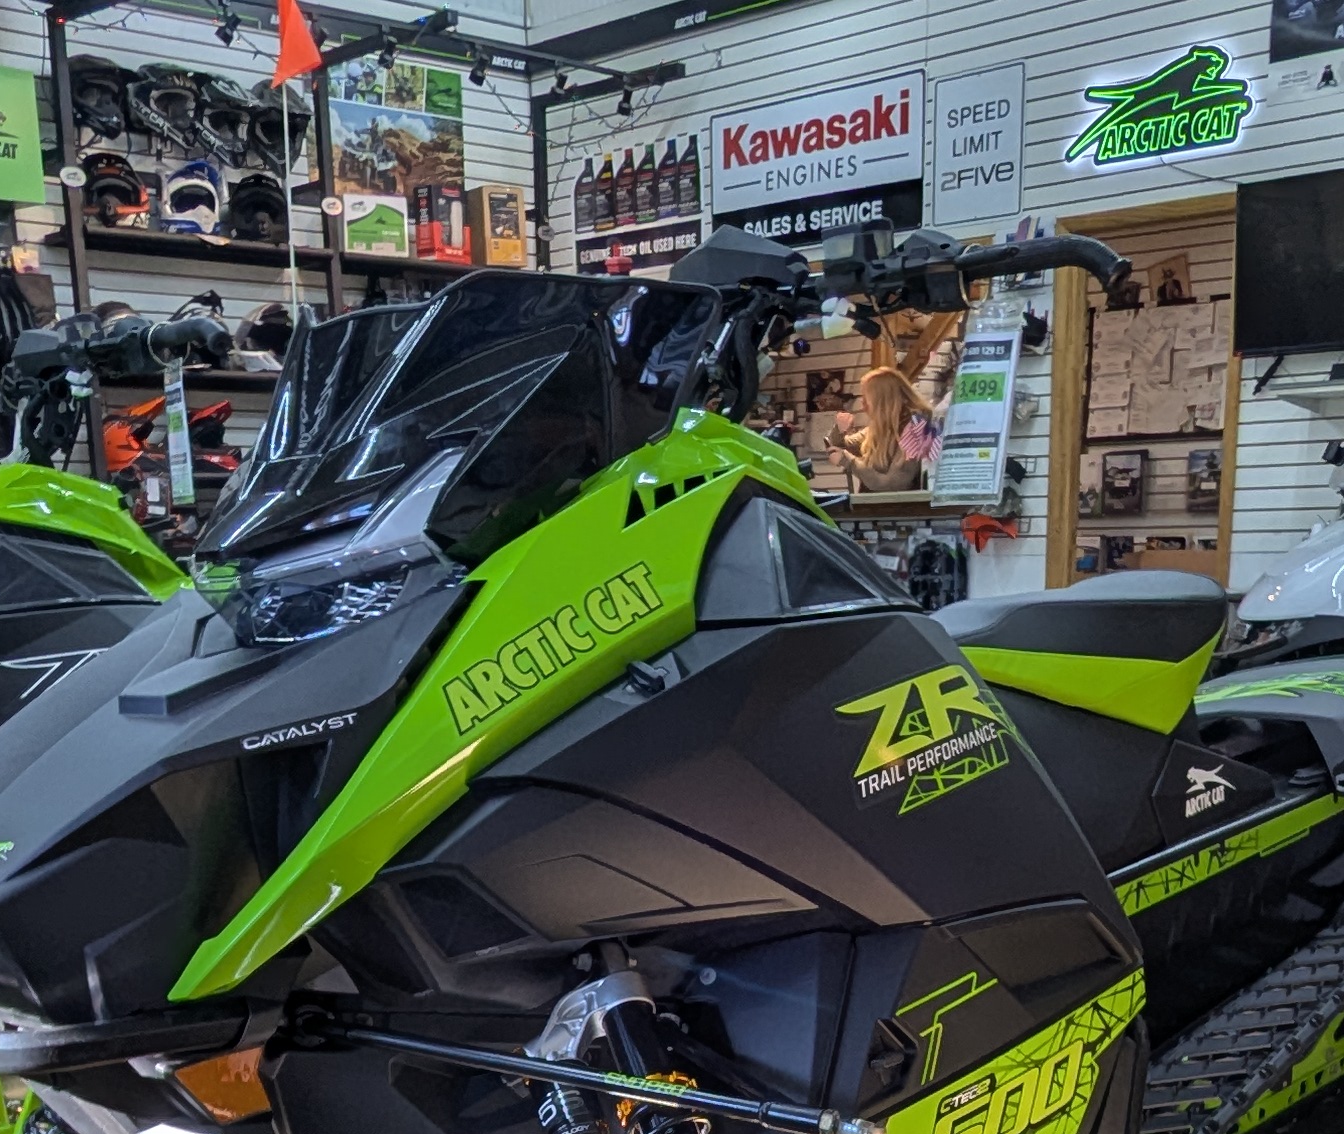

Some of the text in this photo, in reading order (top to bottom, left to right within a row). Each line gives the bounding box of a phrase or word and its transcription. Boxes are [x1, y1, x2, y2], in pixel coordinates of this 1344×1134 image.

[722, 88, 910, 170] Kawasaki
[947, 98, 1010, 129] SPEED
[1098, 102, 1242, 160] ARCTIC CAT
[952, 130, 1003, 158] LIMIT
[765, 155, 858, 192] ENGINES
[744, 200, 884, 238] SALES & SERVICE
[639, 240, 653, 255] OIL
[652, 237, 674, 253] USED
[675, 233, 697, 250] HERE
[442, 561, 664, 736] ARCTIC CAT
[242, 712, 358, 751] CATALYST
[835, 664, 1014, 778] ZR
[858, 722, 998, 798] TRAIL PERFORMANCE
[1185, 785, 1226, 819] ARCTIC CAT
